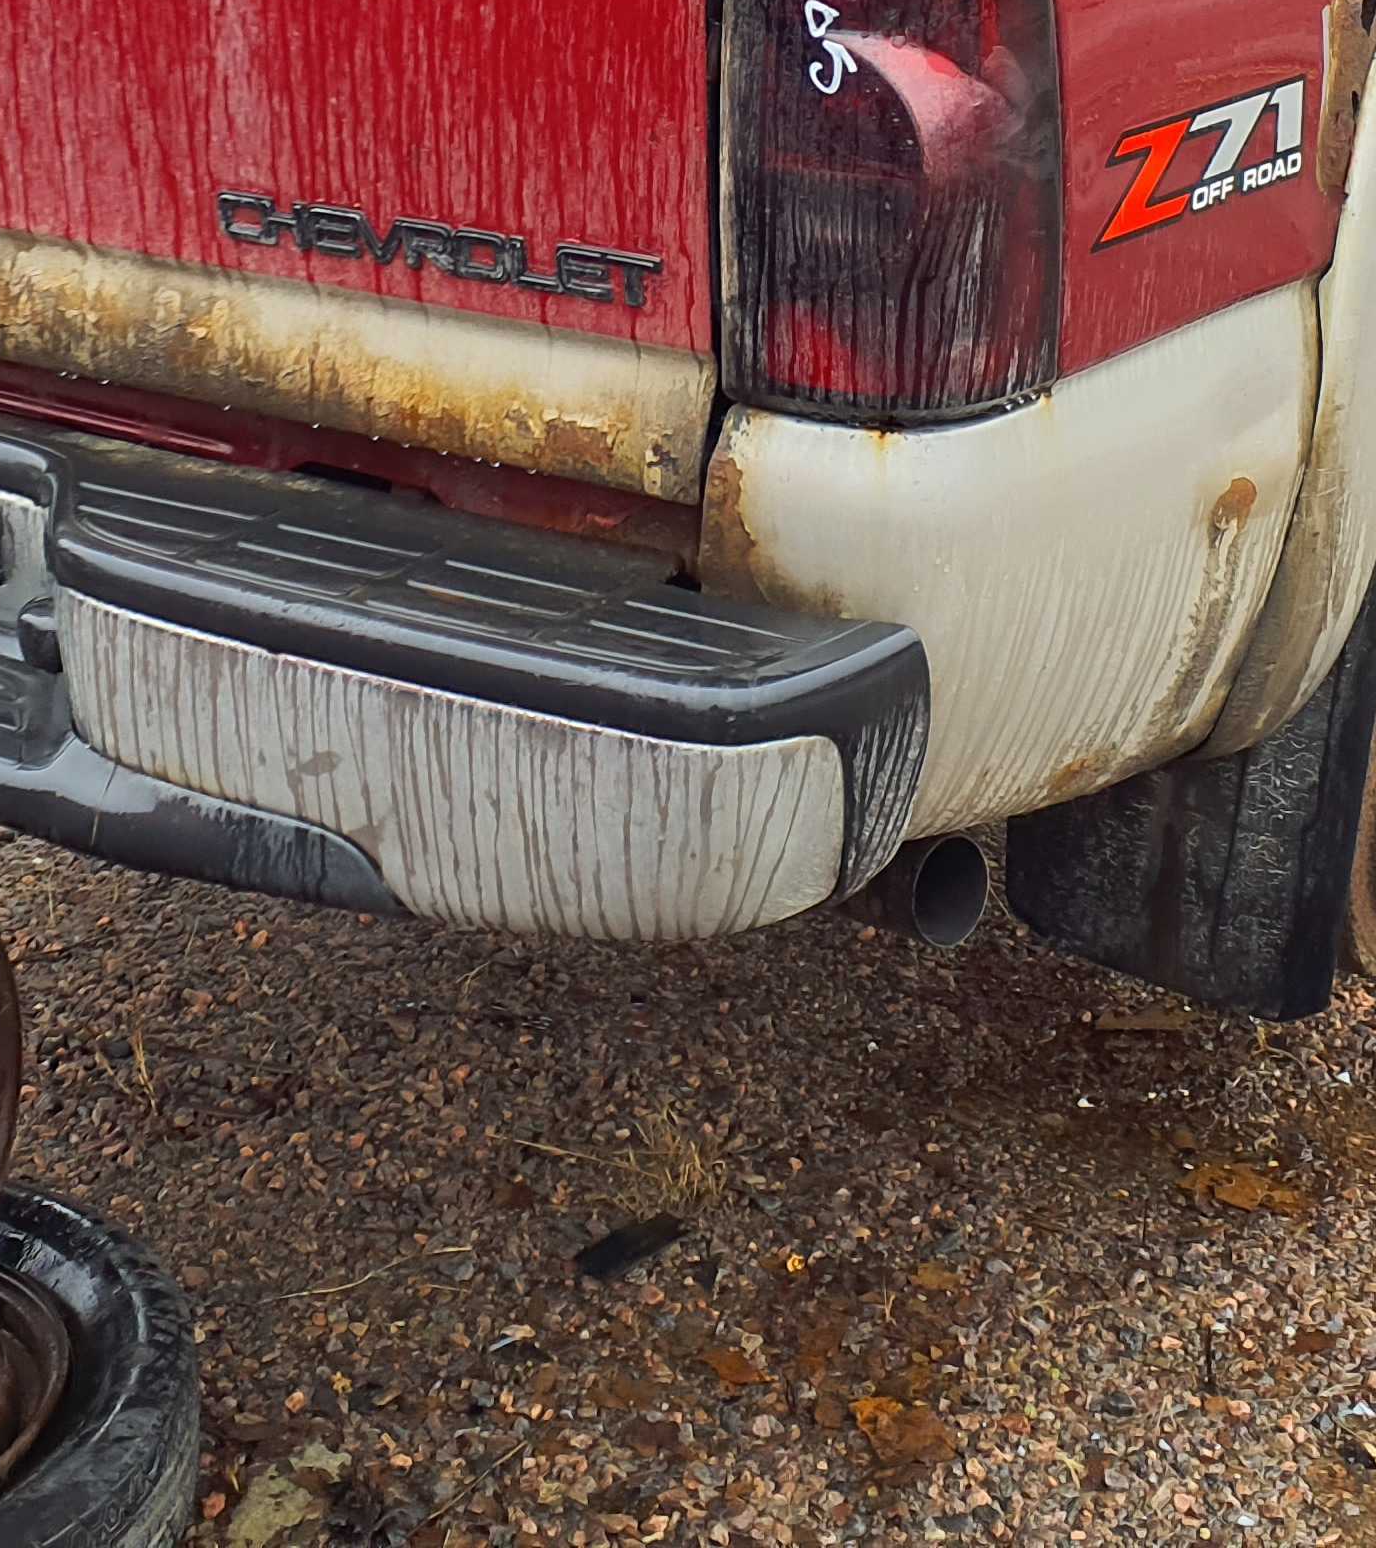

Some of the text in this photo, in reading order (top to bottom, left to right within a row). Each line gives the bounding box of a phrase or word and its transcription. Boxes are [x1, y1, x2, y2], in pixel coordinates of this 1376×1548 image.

[1091, 73, 1307, 253] Z71
[1191, 151, 1303, 212] OFF ROAD
[218, 189, 662, 309] CHEVROLET
